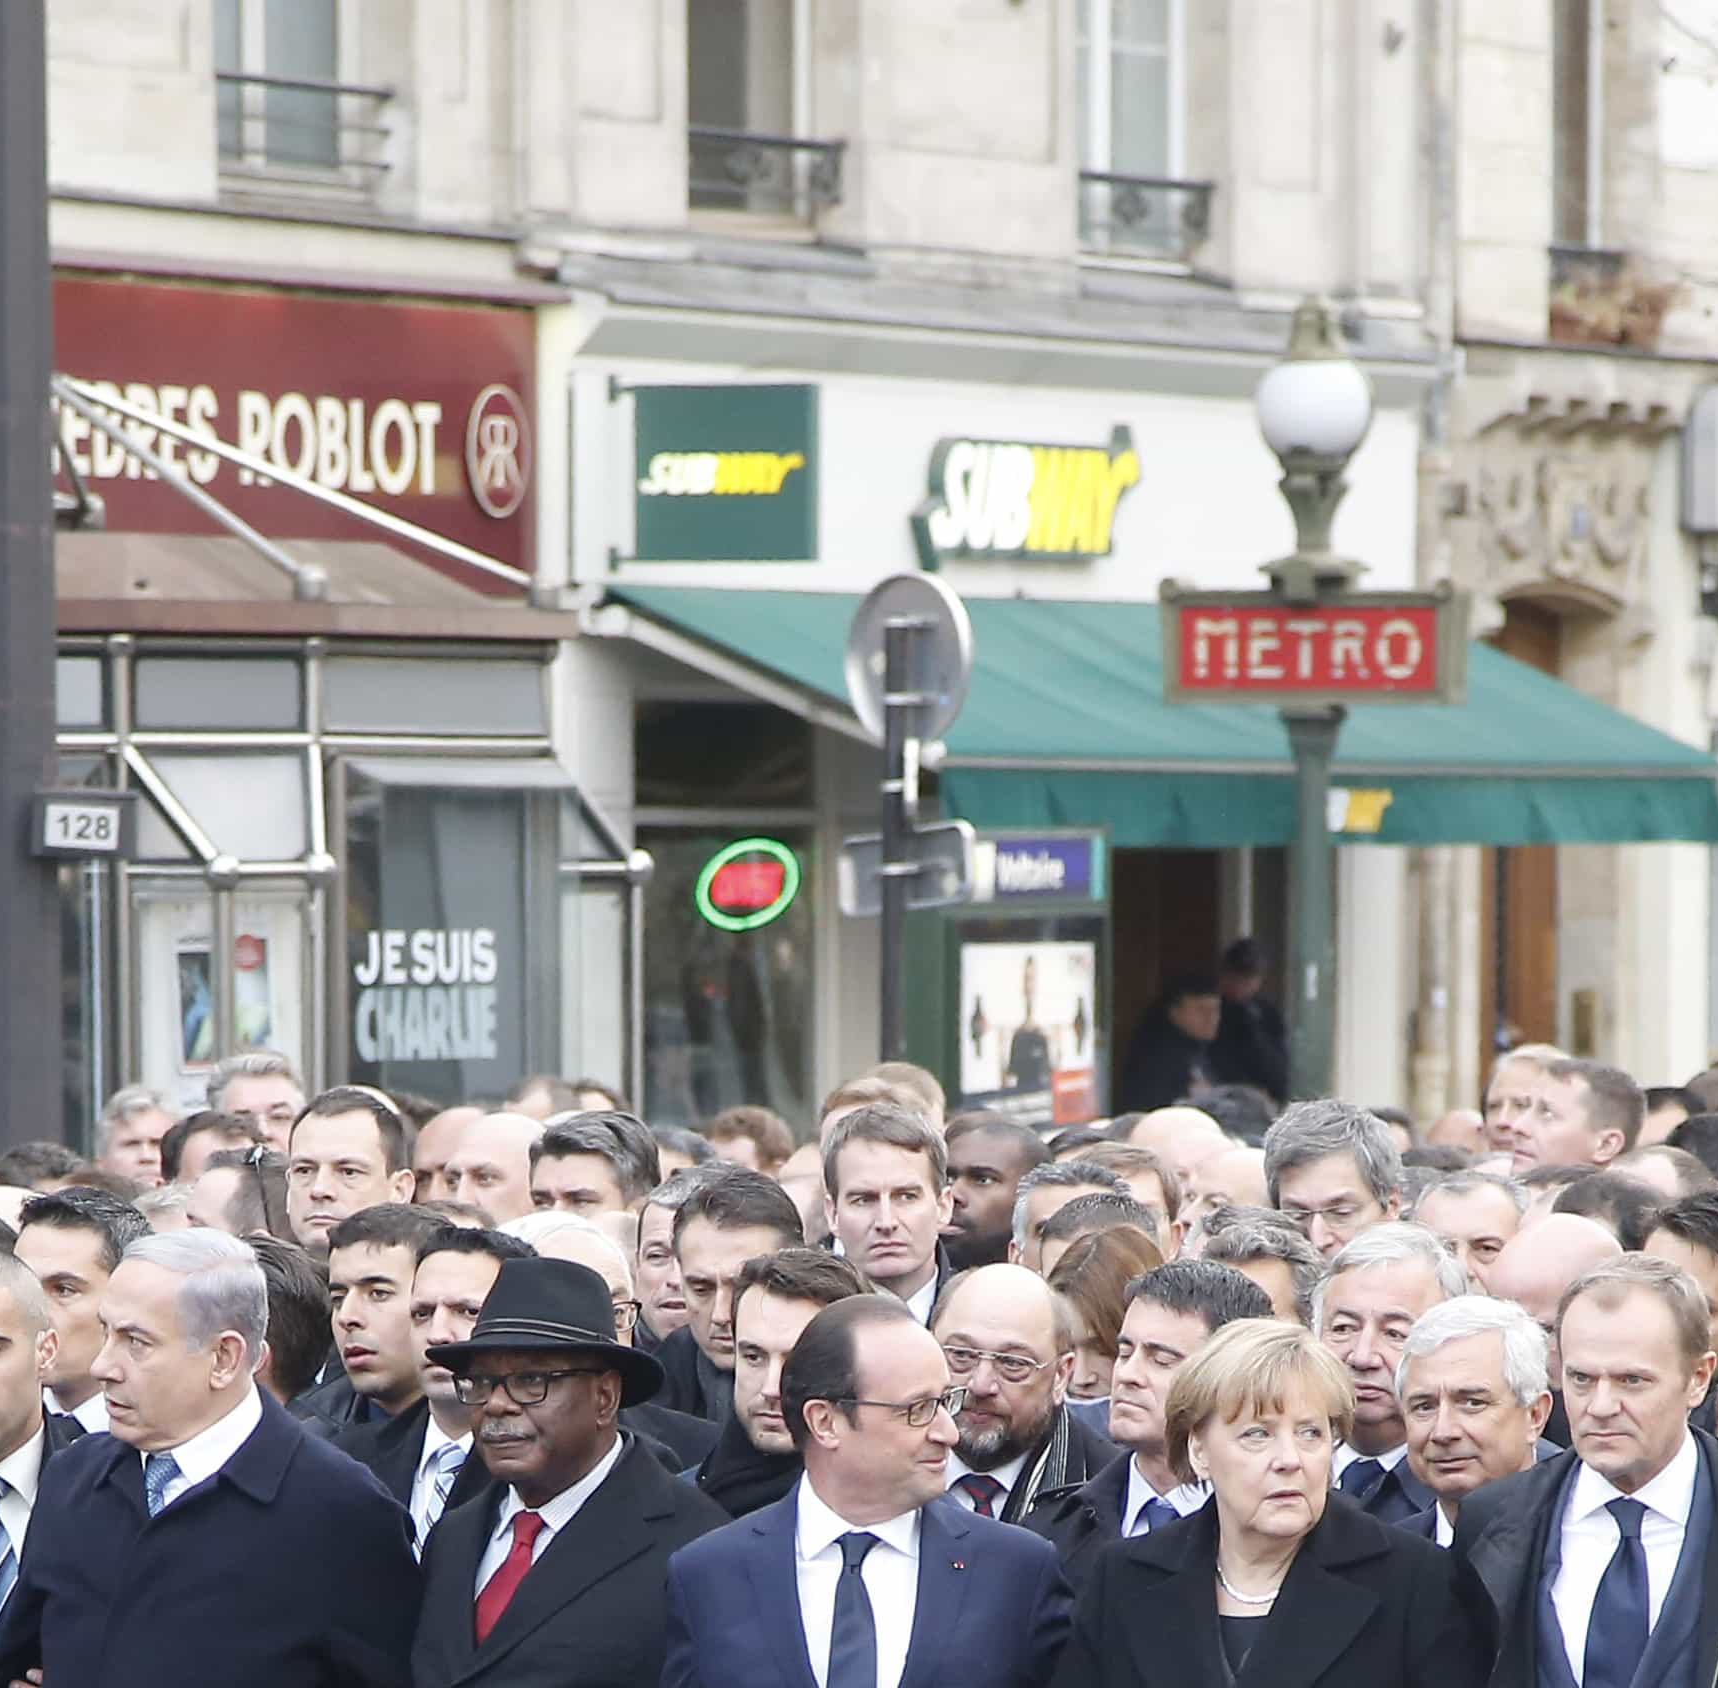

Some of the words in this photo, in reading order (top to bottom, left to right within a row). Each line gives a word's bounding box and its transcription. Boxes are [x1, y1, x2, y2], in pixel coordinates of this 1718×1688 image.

[238, 390, 443, 496] ROBLOT
[638, 451, 805, 495] SUBWAY
[929, 438, 1141, 554] SUBWAY
[1193, 617, 1423, 680] METRO
[57, 813, 111, 840] 128
[354, 929, 408, 986] JE
[410, 927, 498, 986] SUIS
[356, 987, 498, 1062] CHARLIE
